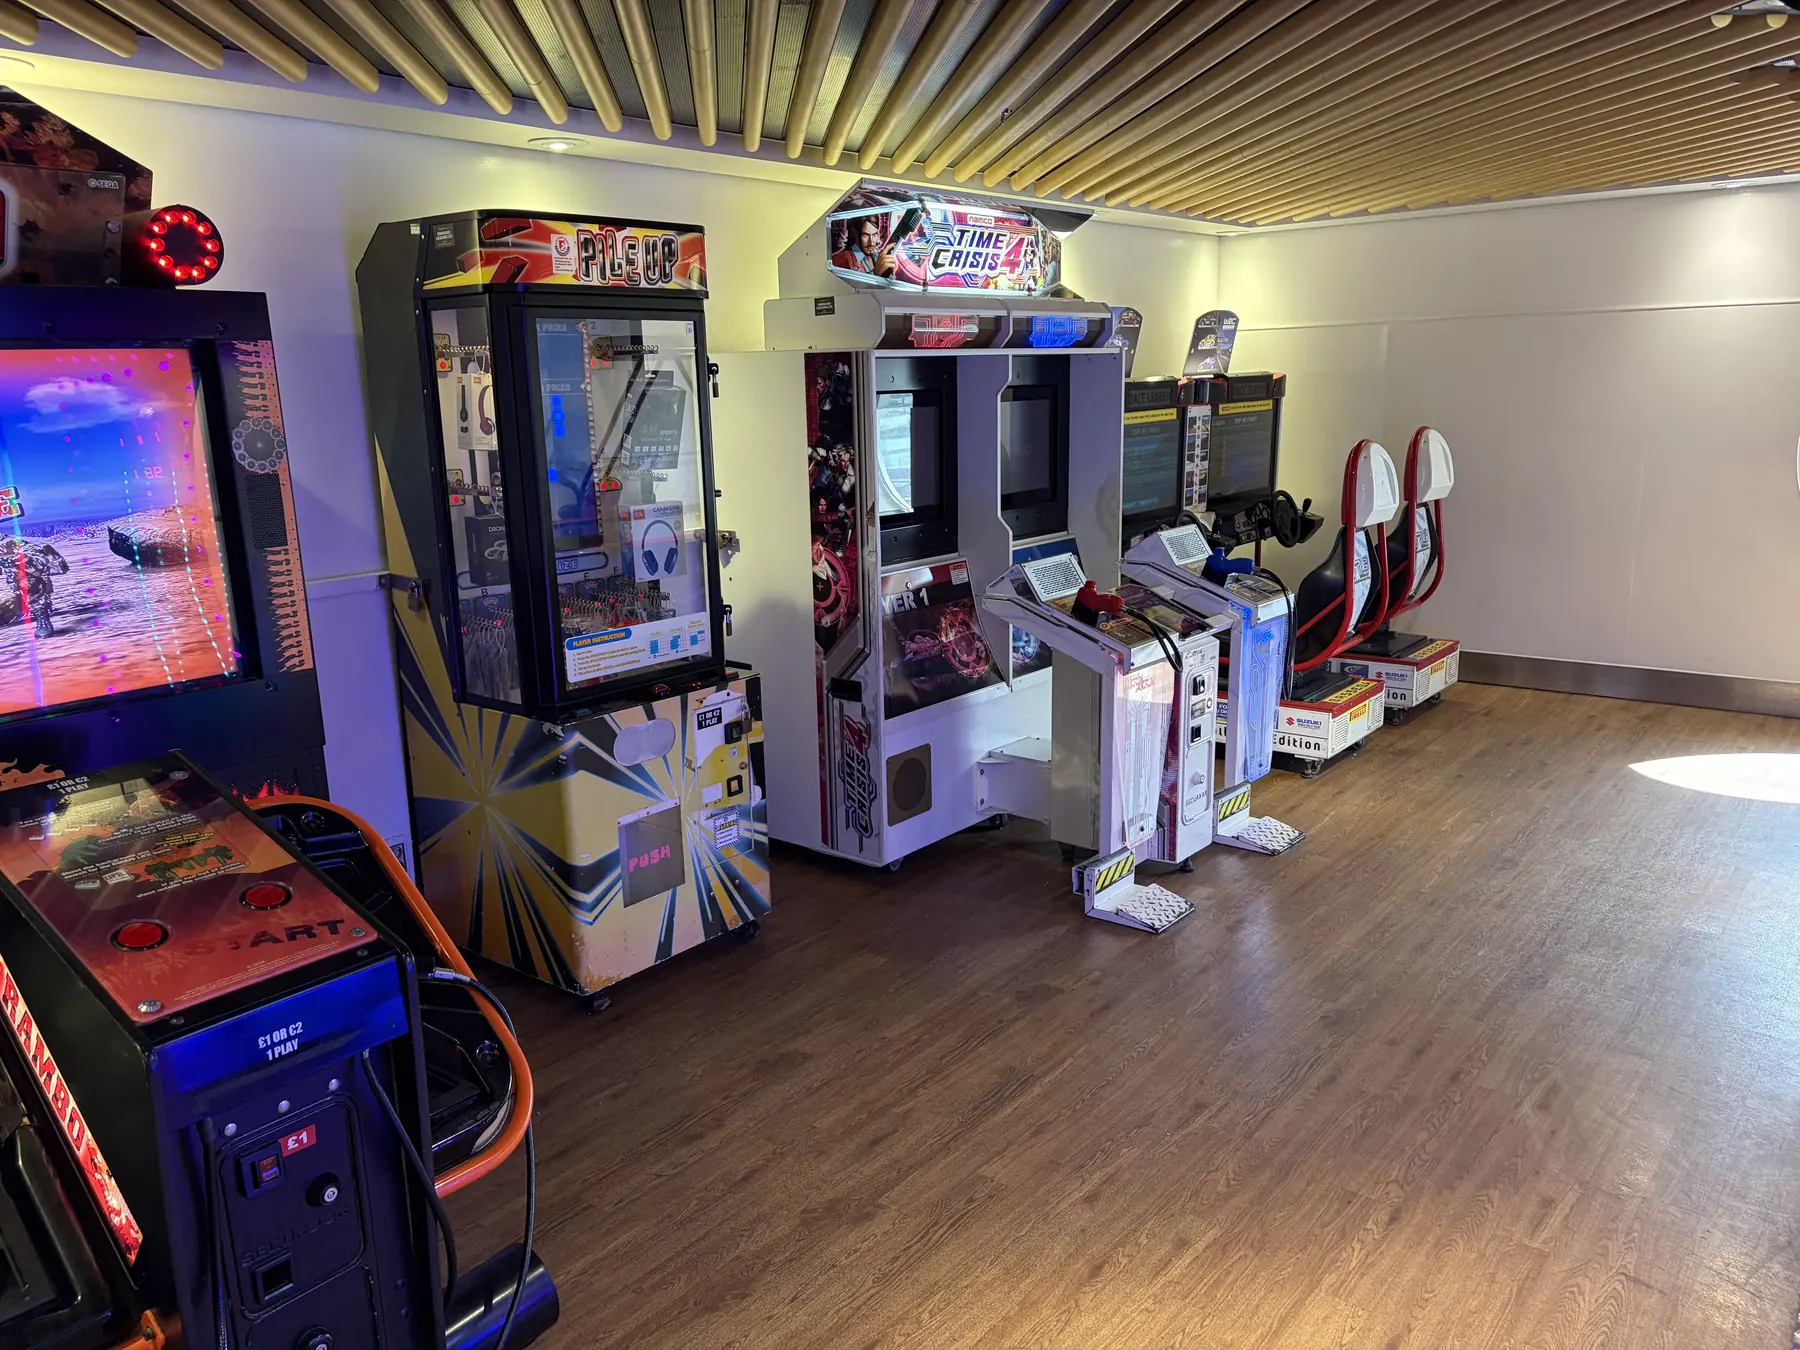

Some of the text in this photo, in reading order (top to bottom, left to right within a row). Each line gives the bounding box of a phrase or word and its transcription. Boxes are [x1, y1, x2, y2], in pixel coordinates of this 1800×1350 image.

[968, 215, 993, 225] namco
[955, 229, 1008, 250] TIME
[578, 229, 678, 286] PILE UP
[931, 236, 1026, 275] CRISIS 4
[590, 322, 596, 330] 2
[489, 525, 506, 533] DRON
[481, 588, 489, 596] B
[881, 587, 930, 615] YER 1
[573, 632, 626, 648] PLAYER INSTRUCTION
[706, 712, 713, 720] OR
[706, 716, 718, 726] PLAY
[1296, 718, 1322, 726] SUZUKI
[60, 779, 76, 788] OR
[65, 782, 89, 793] PLAY
[628, 844, 672, 873] PUSH
[61, 868, 82, 877] Shoot
[64, 870, 88, 880] search
[136, 890, 156, 899] shoot
[157, 882, 181, 892] outside
[258, 1032, 272, 1050] £1
[272, 1027, 288, 1043] OR
[266, 1038, 300, 1061] 1 PLAY
[1, 972, 88, 1152] RAMBO
[287, 1130, 308, 1150] £1
